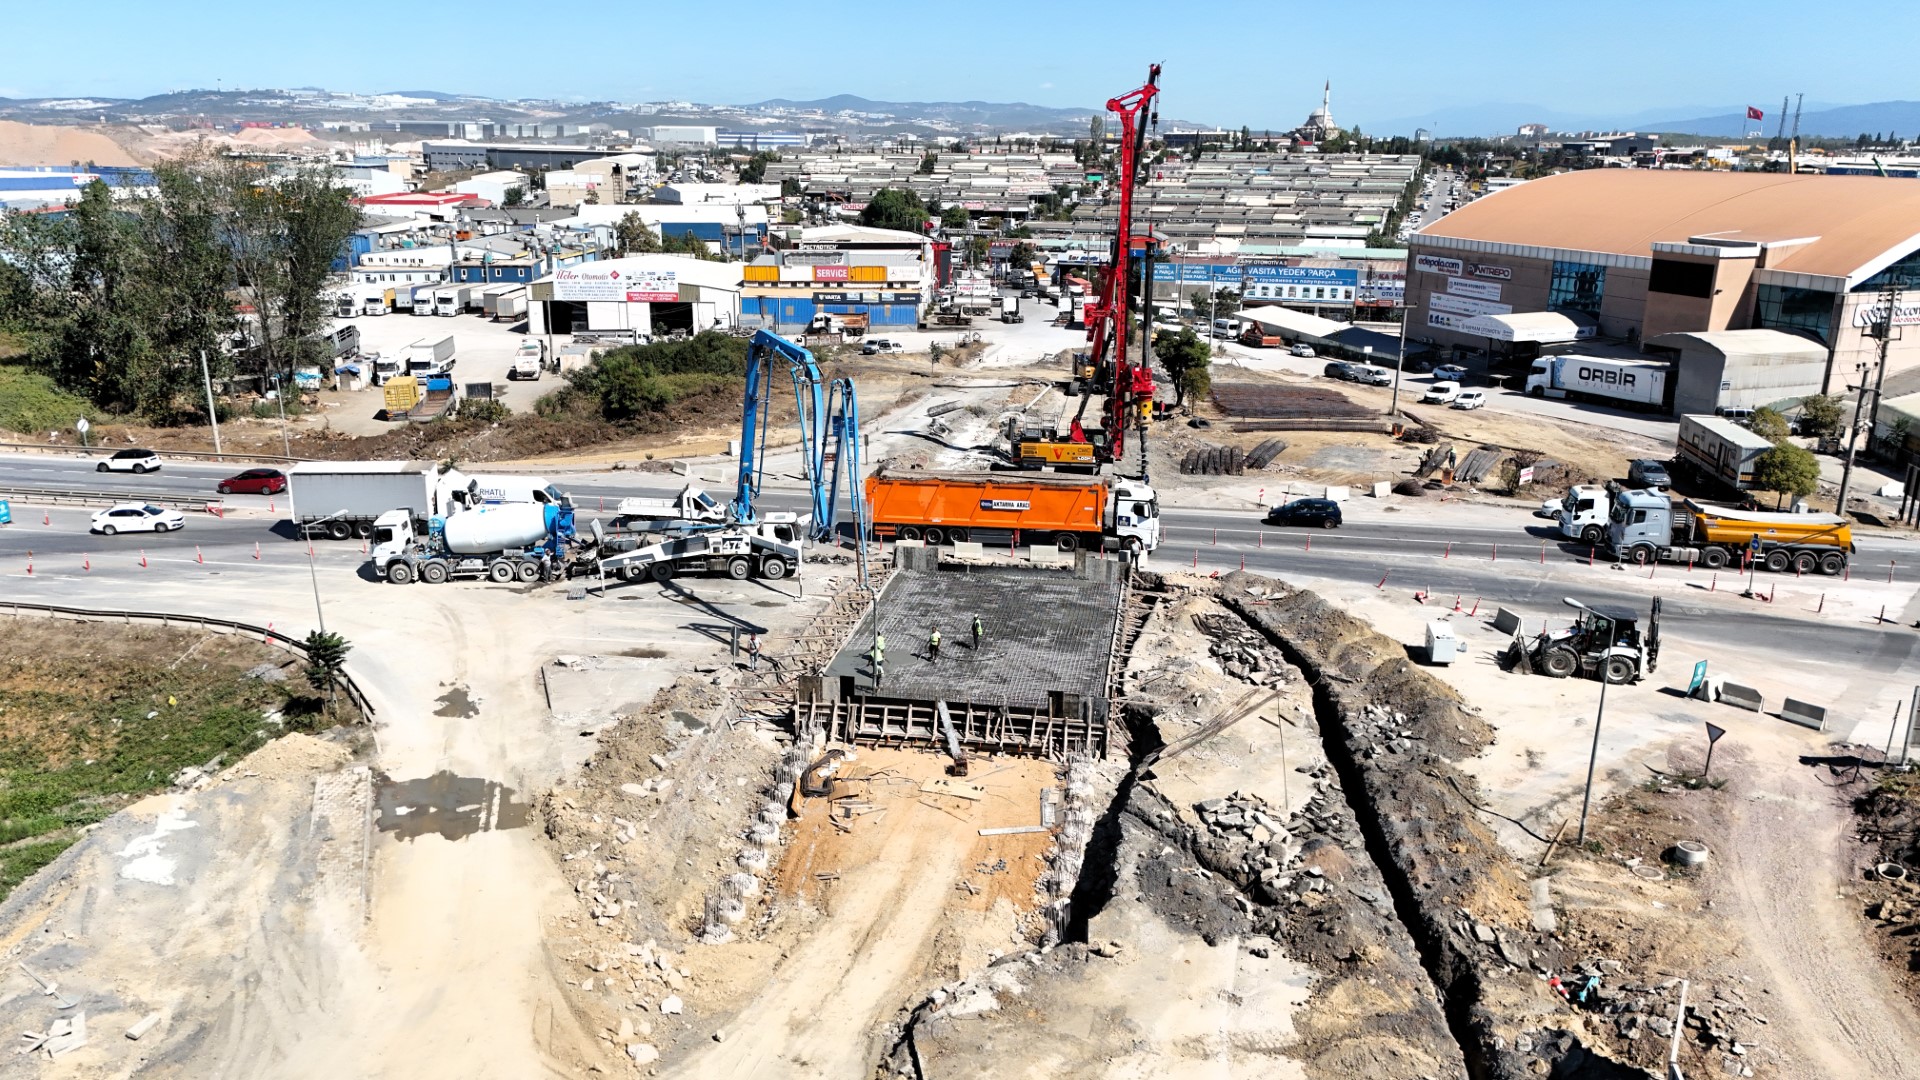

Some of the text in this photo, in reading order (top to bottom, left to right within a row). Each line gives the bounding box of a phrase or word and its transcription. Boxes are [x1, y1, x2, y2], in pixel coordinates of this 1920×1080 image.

[1278, 268, 1306, 277] YEDEK
[1307, 269, 1337, 279] PARÇA
[1578, 367, 1636, 387] ORBİR
[480, 488, 506, 496] RHATLI
